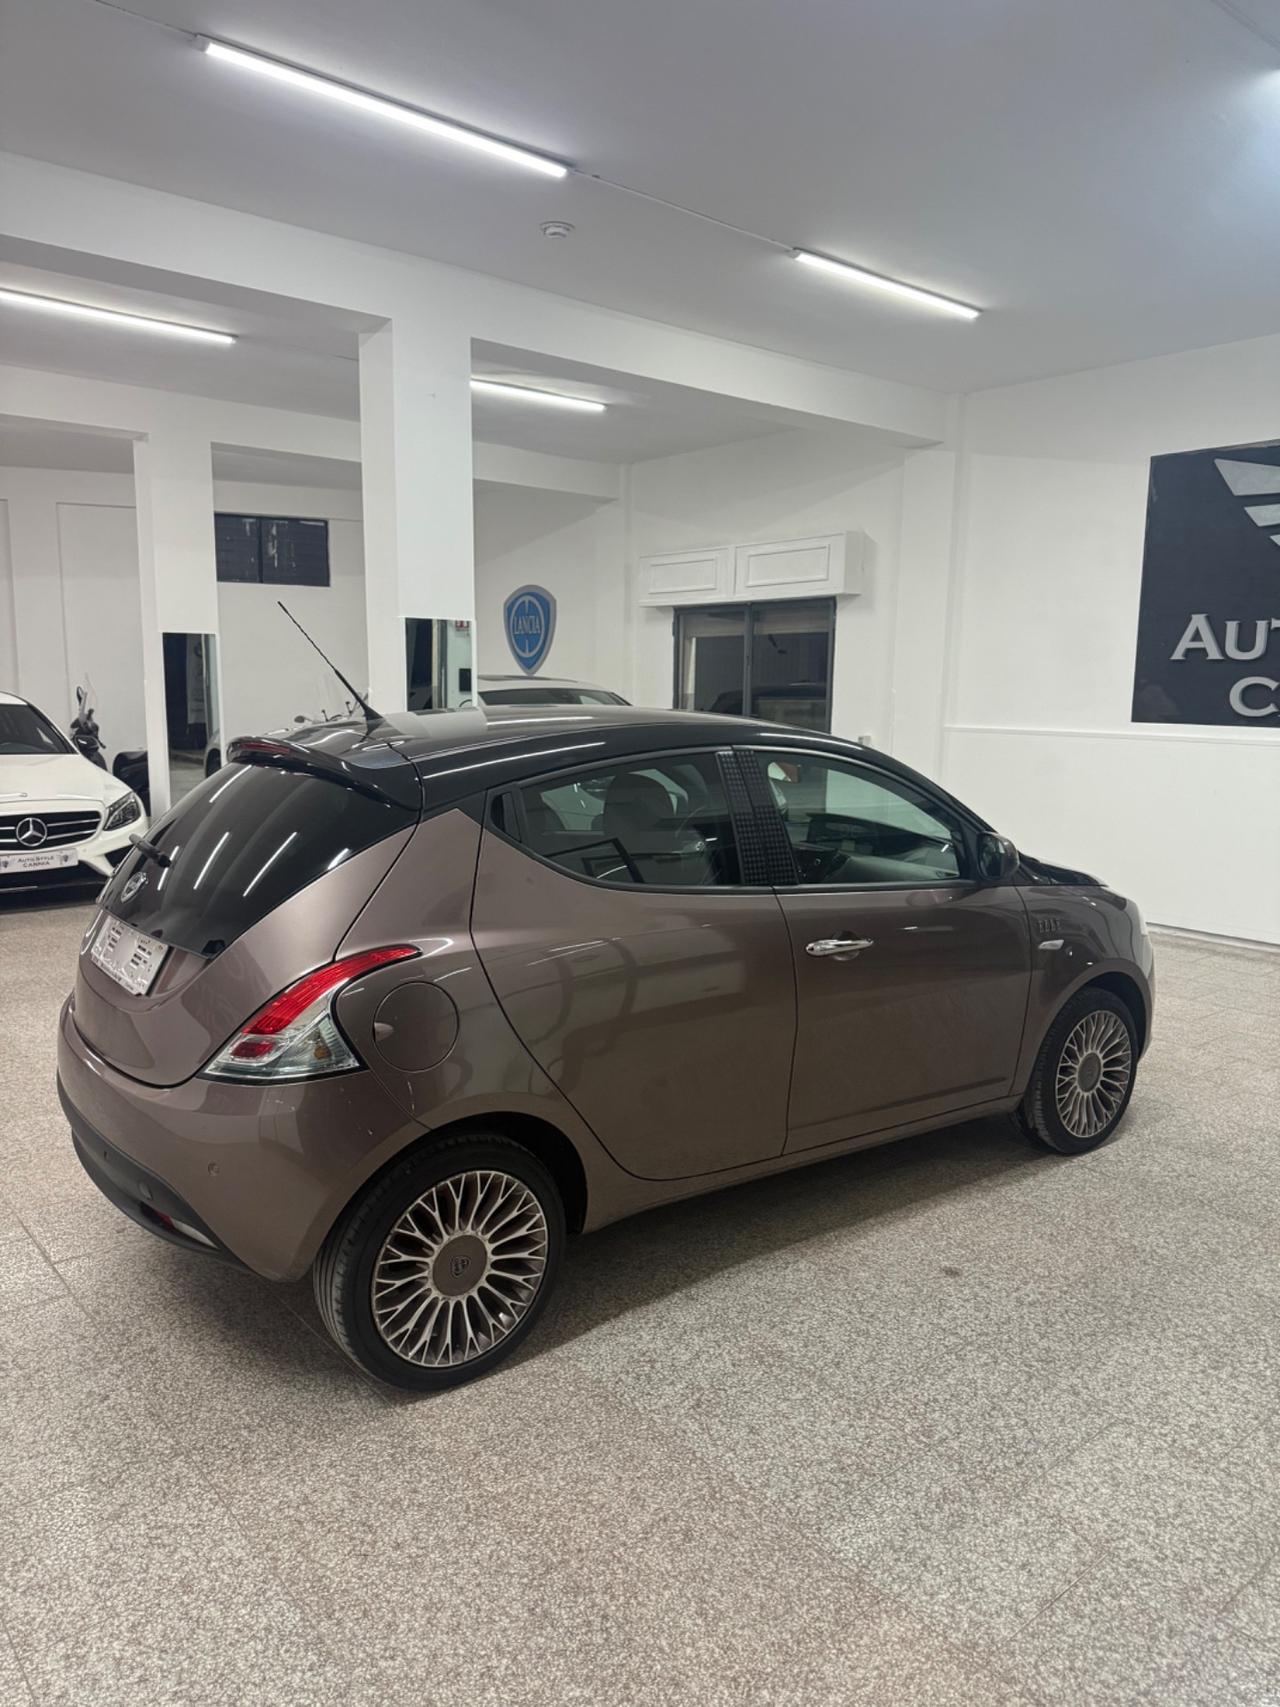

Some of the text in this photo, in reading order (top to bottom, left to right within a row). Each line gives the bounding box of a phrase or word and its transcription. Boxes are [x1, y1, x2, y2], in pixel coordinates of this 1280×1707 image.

[513, 615, 541, 635] LANCIA
[1169, 613, 1280, 660] AU
[1229, 676, 1280, 717] C
